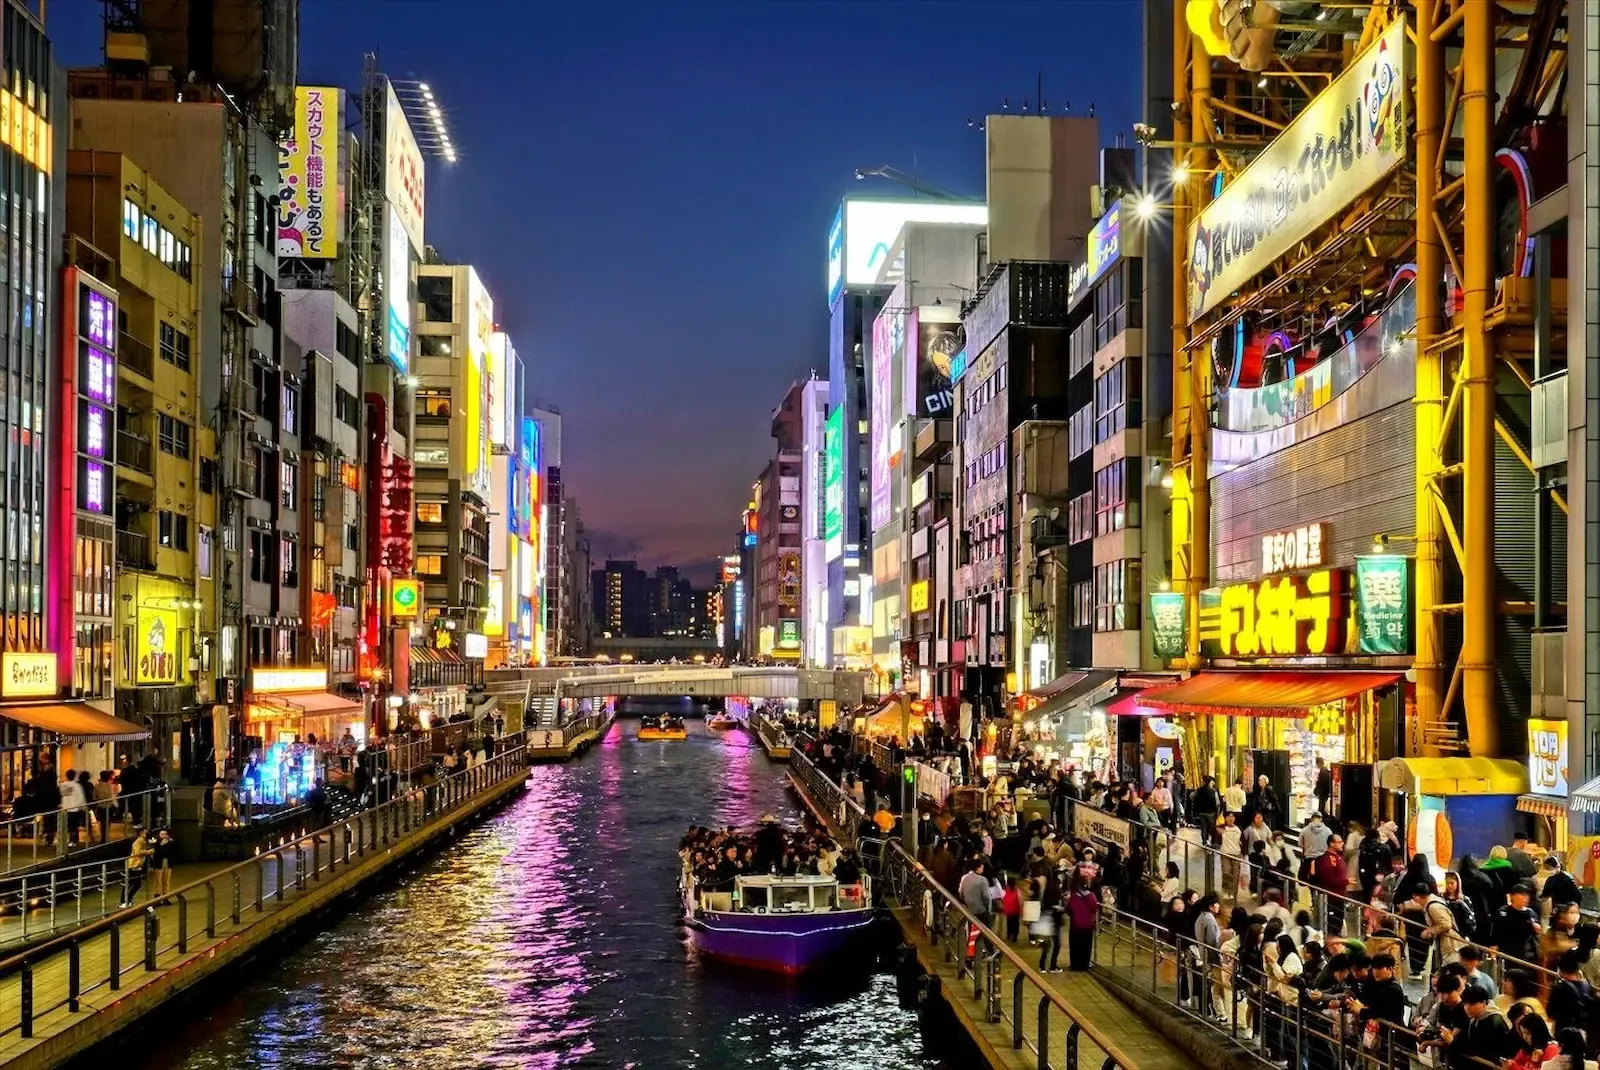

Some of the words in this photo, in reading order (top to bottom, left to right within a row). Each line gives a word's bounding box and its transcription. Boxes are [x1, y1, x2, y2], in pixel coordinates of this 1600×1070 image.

[306, 91, 323, 253] スカウト機能もあるで
